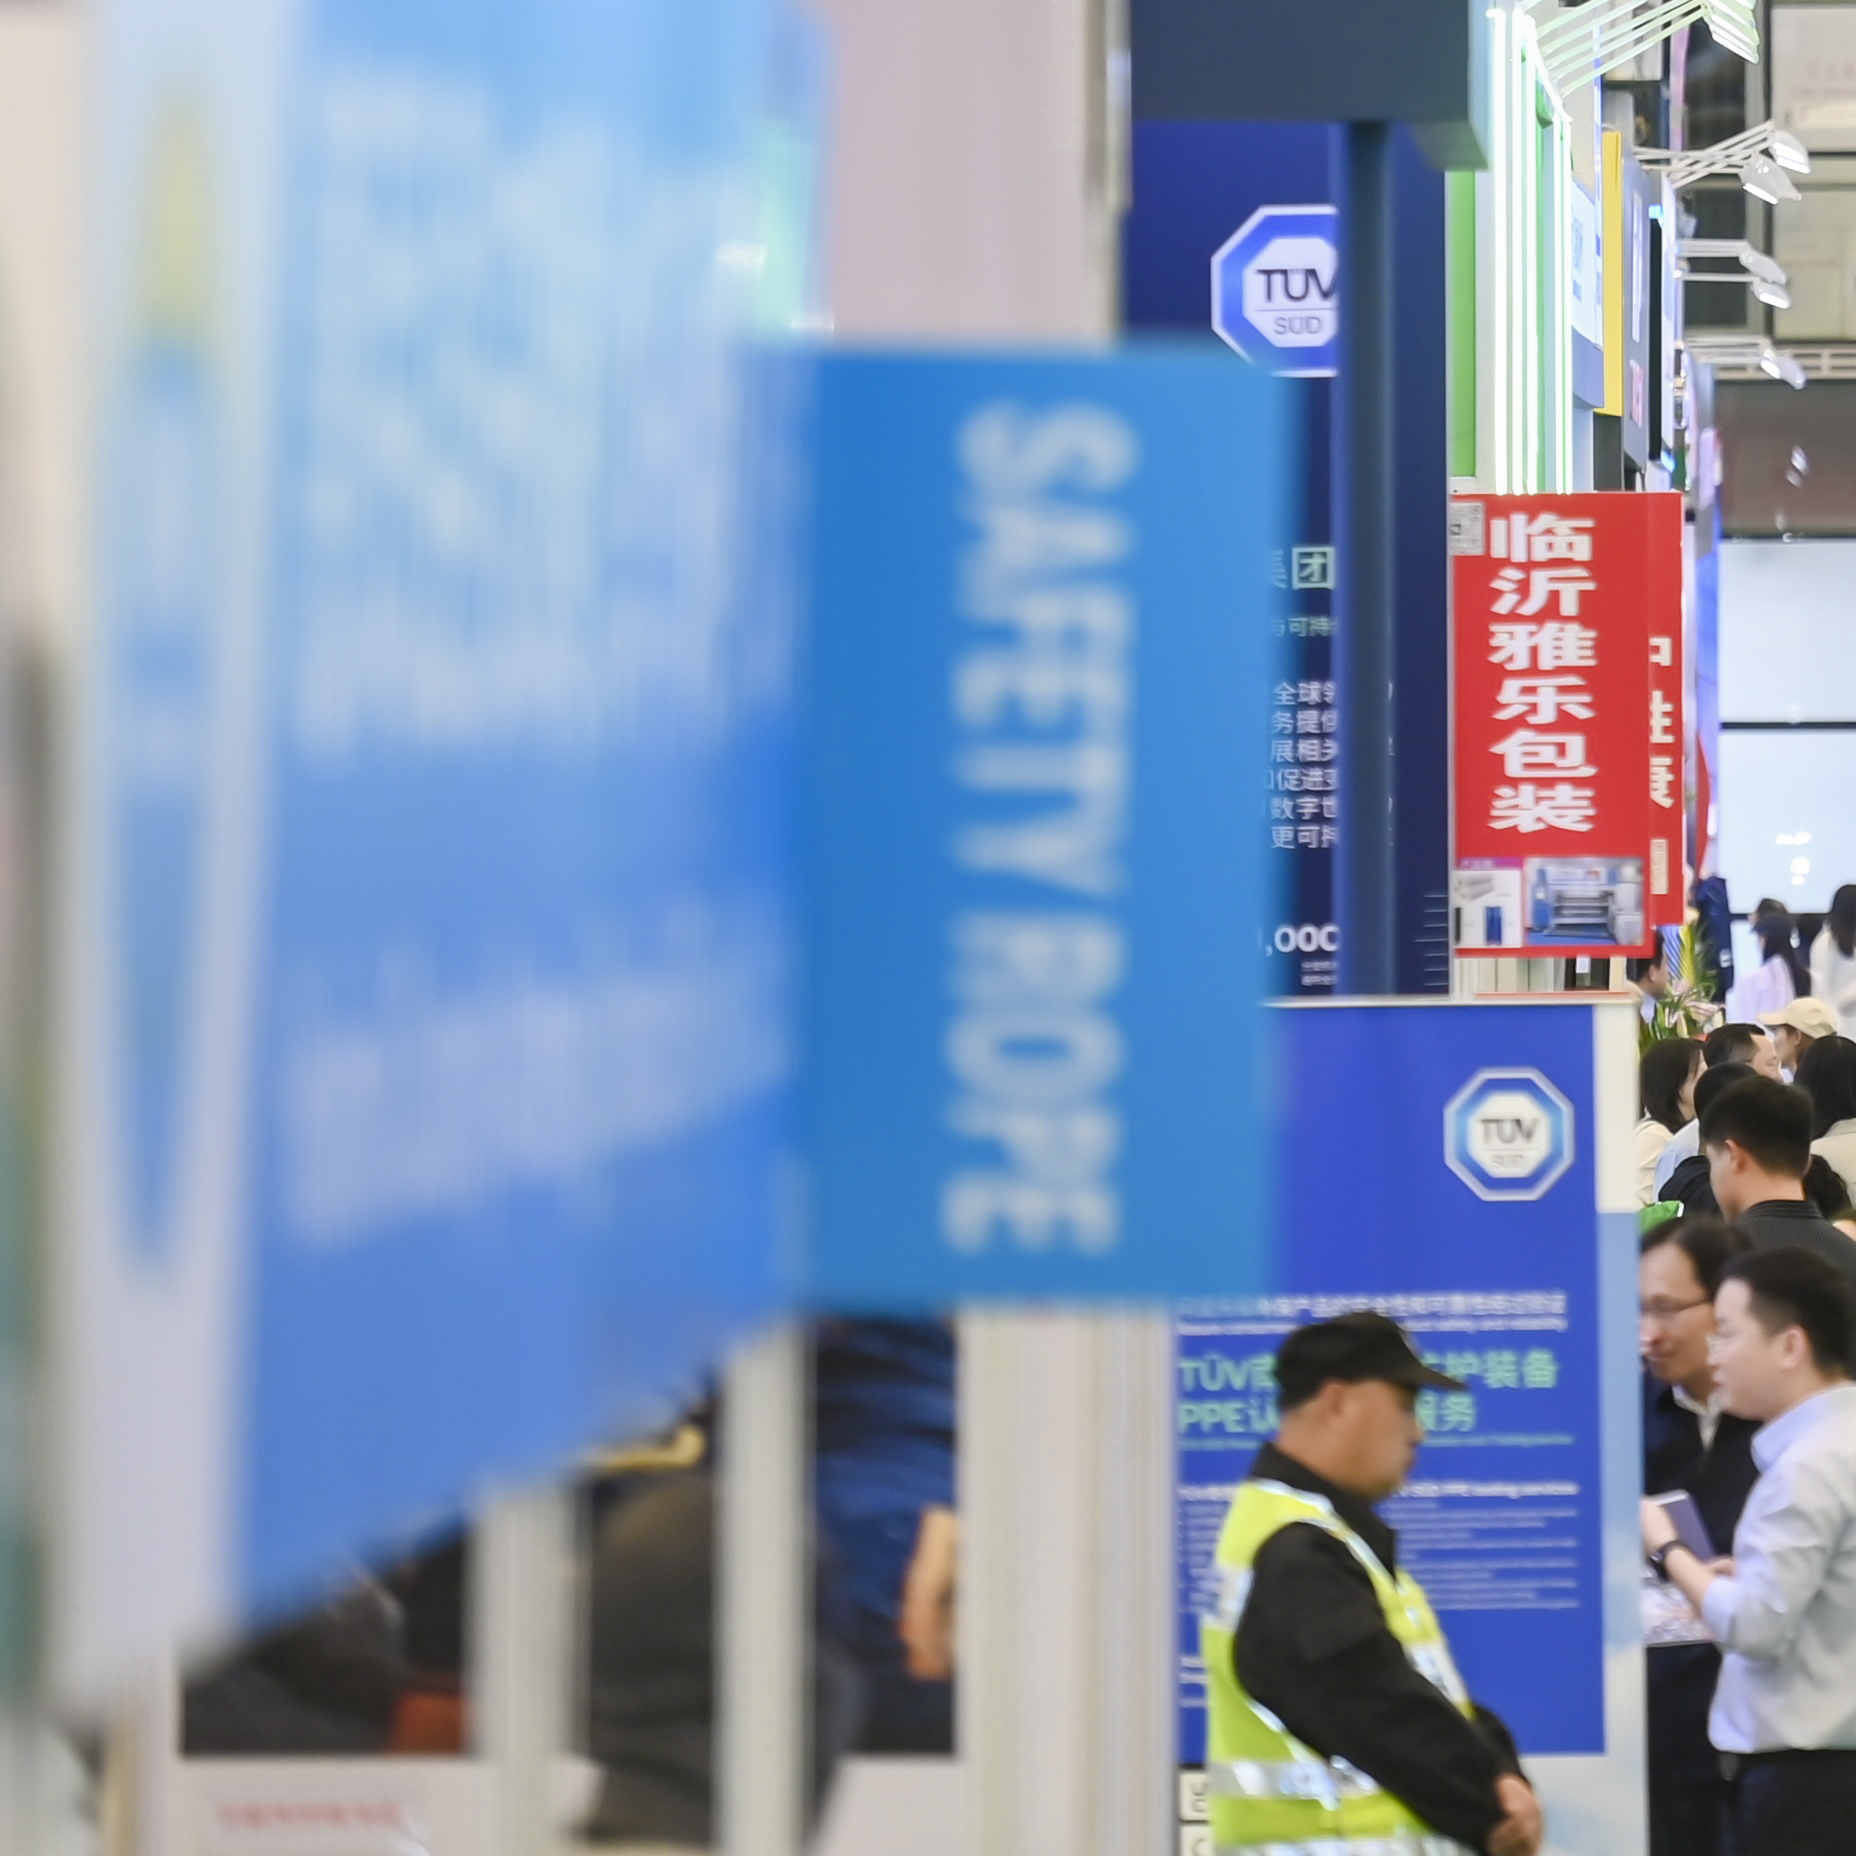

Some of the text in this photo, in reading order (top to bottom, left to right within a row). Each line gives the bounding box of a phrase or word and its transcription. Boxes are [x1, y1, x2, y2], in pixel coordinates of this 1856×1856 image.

[938, 396, 1142, 1256] SAFETY ROPE
[1487, 511, 1598, 834] 临沂雅乐包装
